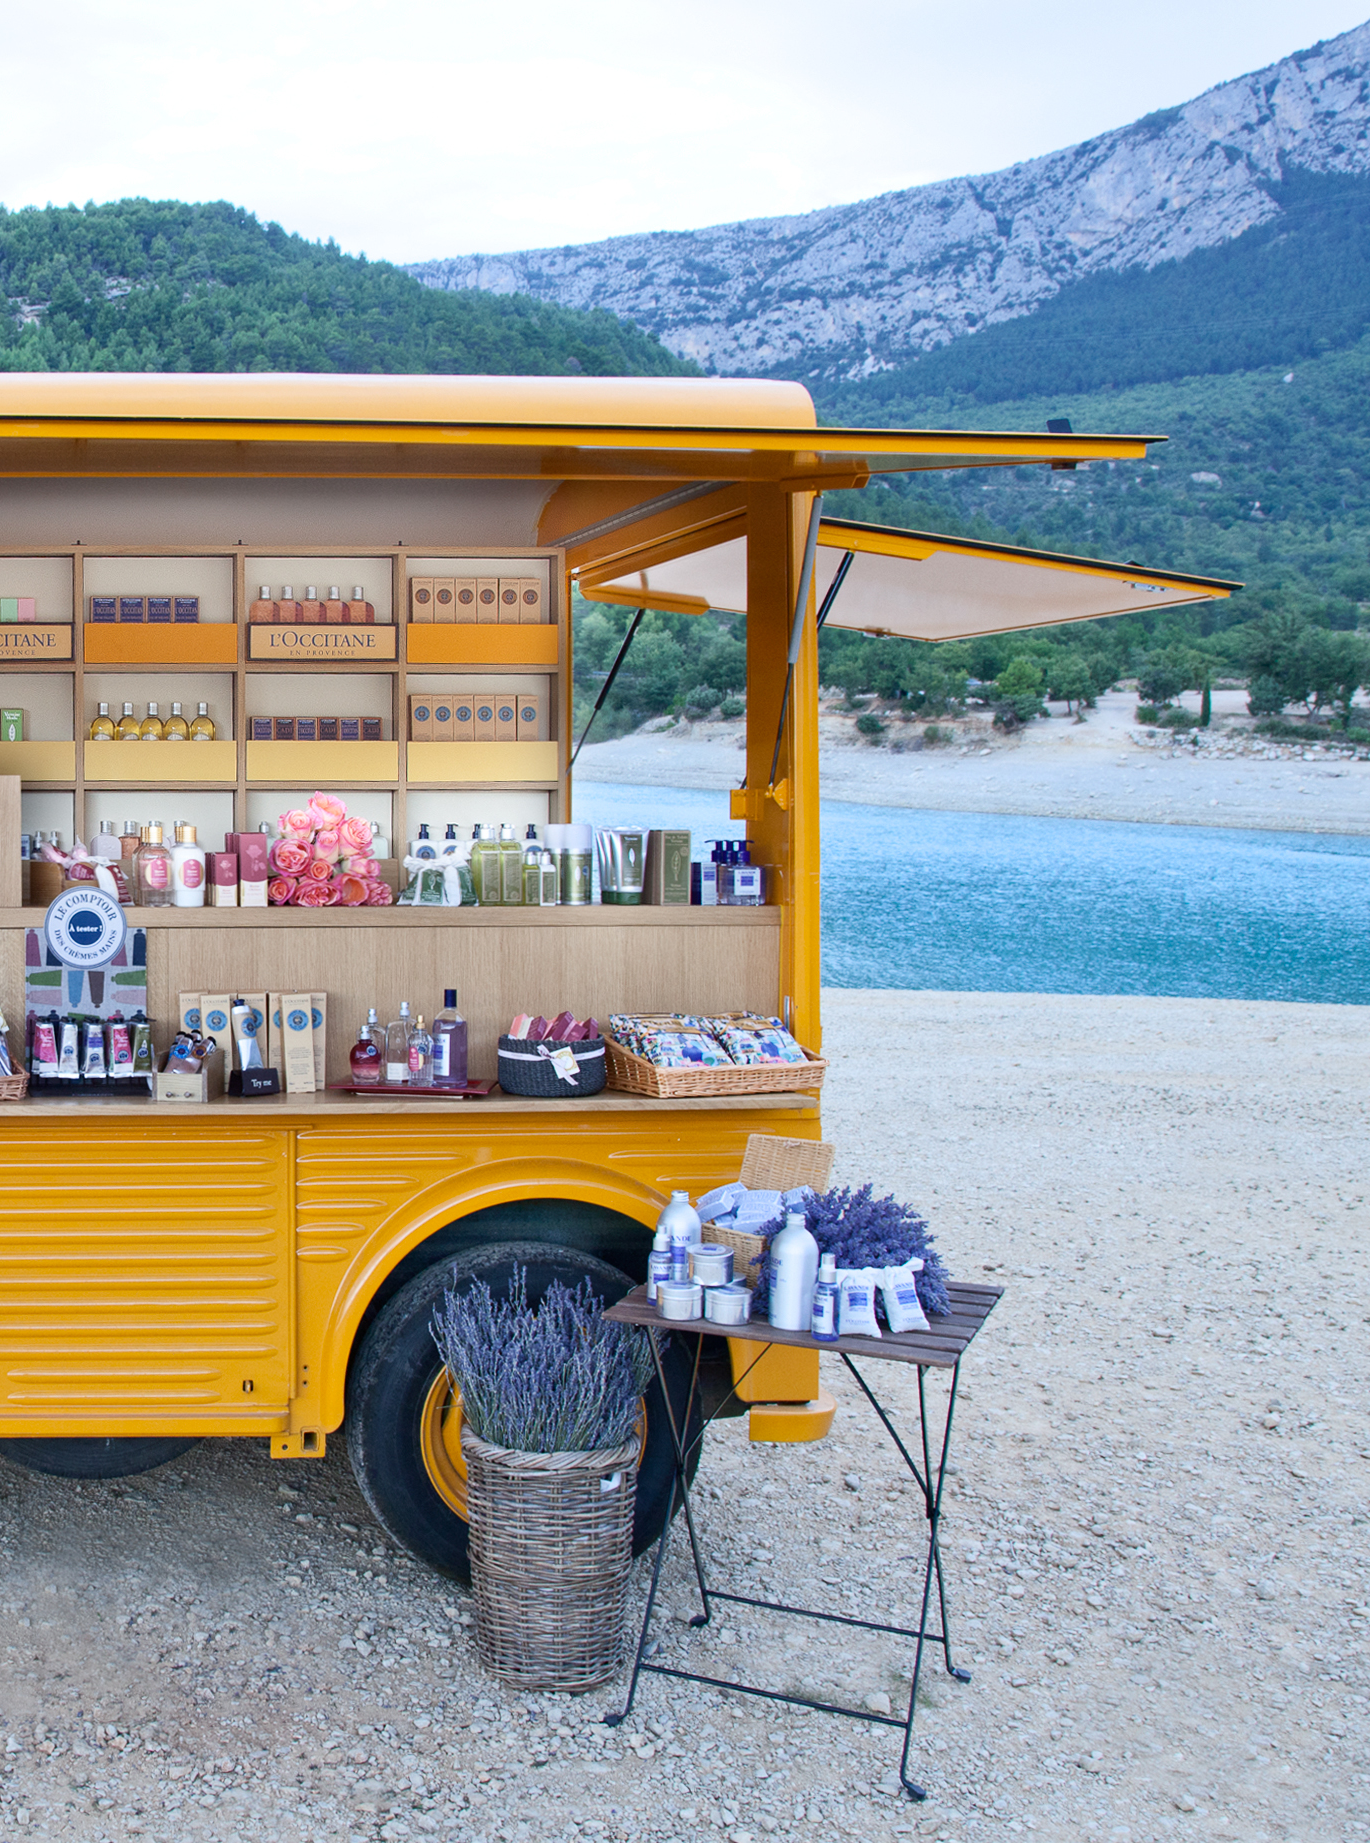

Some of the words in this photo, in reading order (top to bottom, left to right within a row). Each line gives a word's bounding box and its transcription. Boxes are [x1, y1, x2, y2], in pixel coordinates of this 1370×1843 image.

[270, 631, 376, 647] L'OCCITANE
[54, 906, 67, 921] LE
[66, 894, 117, 921] COMPTOIR
[69, 924, 75, 932] À
[54, 929, 65, 946] DES
[64, 946, 98, 960] CRÈMES
[99, 930, 117, 954] MAINS
[251, 1079, 262, 1088] Try
